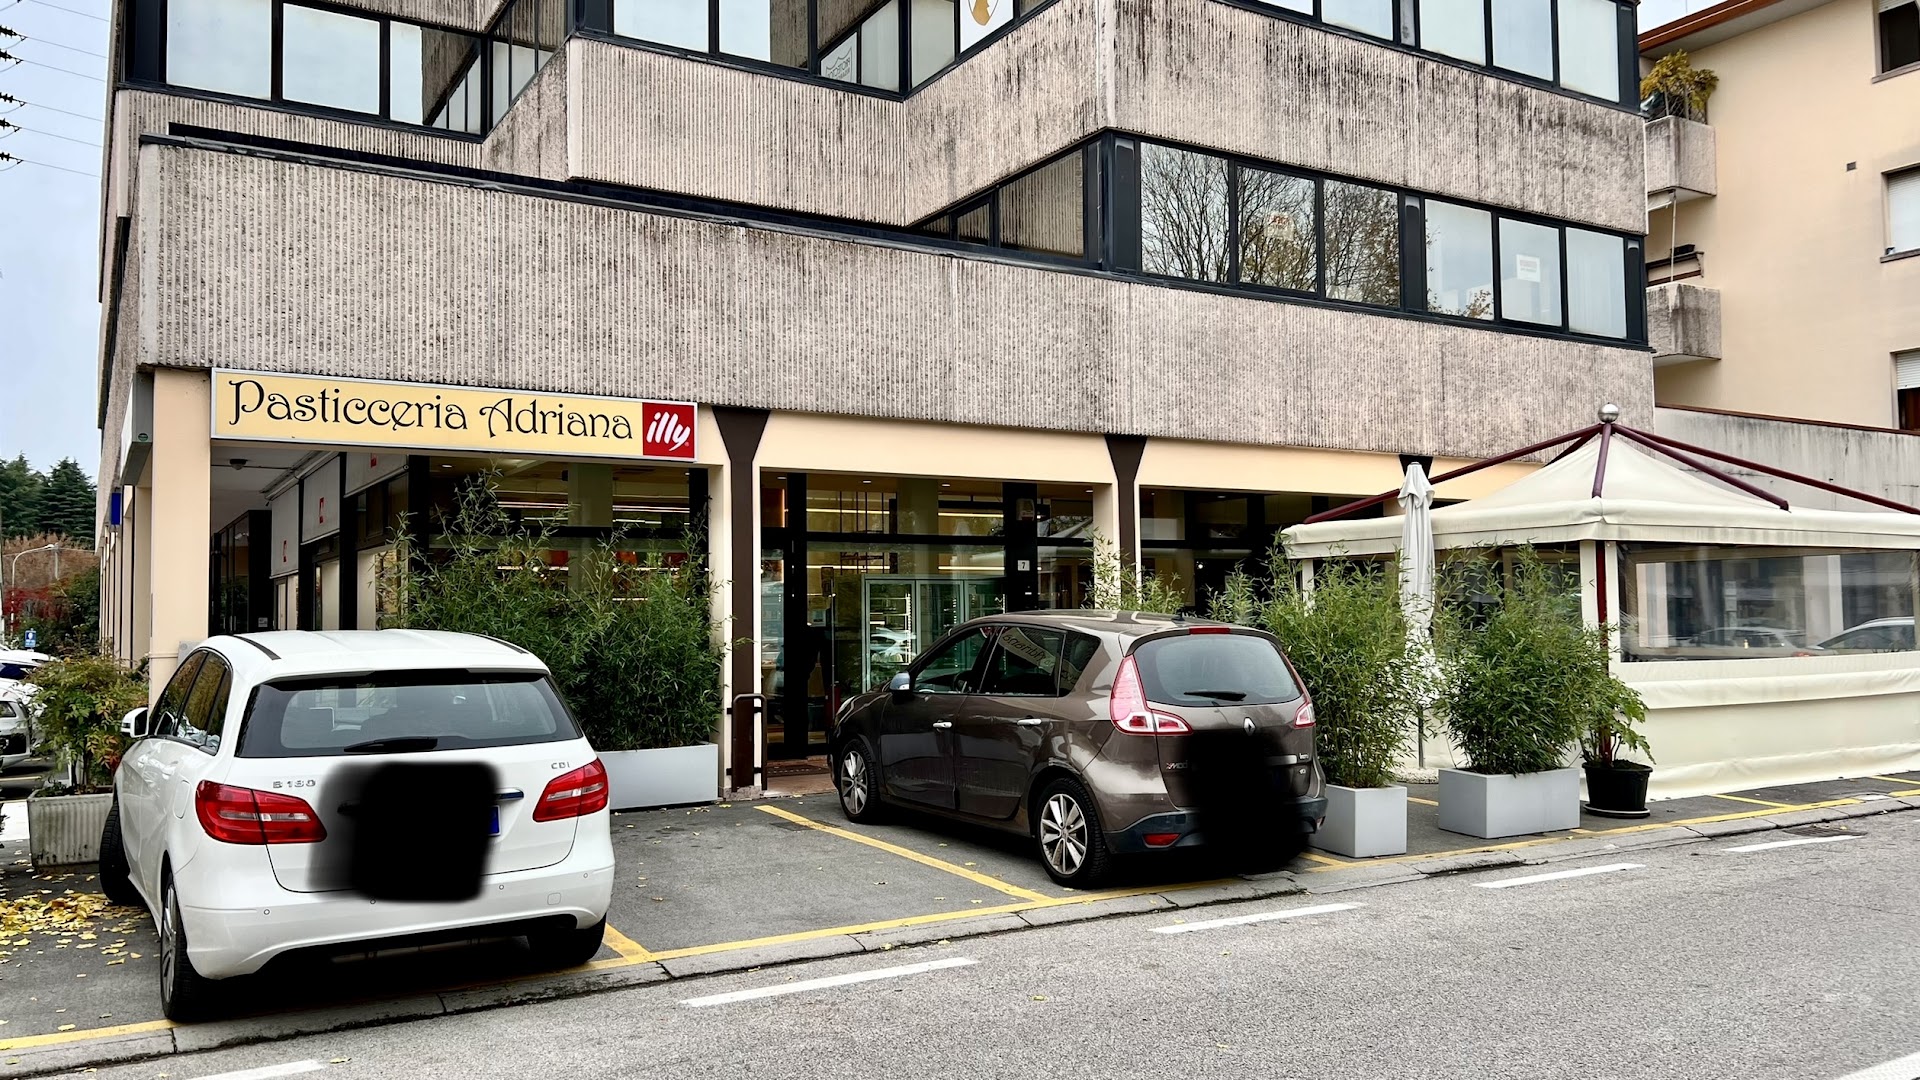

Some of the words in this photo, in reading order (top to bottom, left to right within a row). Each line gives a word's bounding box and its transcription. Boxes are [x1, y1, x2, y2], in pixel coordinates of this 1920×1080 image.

[228, 379, 468, 431] Pasticceria
[479, 398, 633, 439] Adriana
[646, 411, 691, 452] illy
[551, 761, 571, 770] CDI
